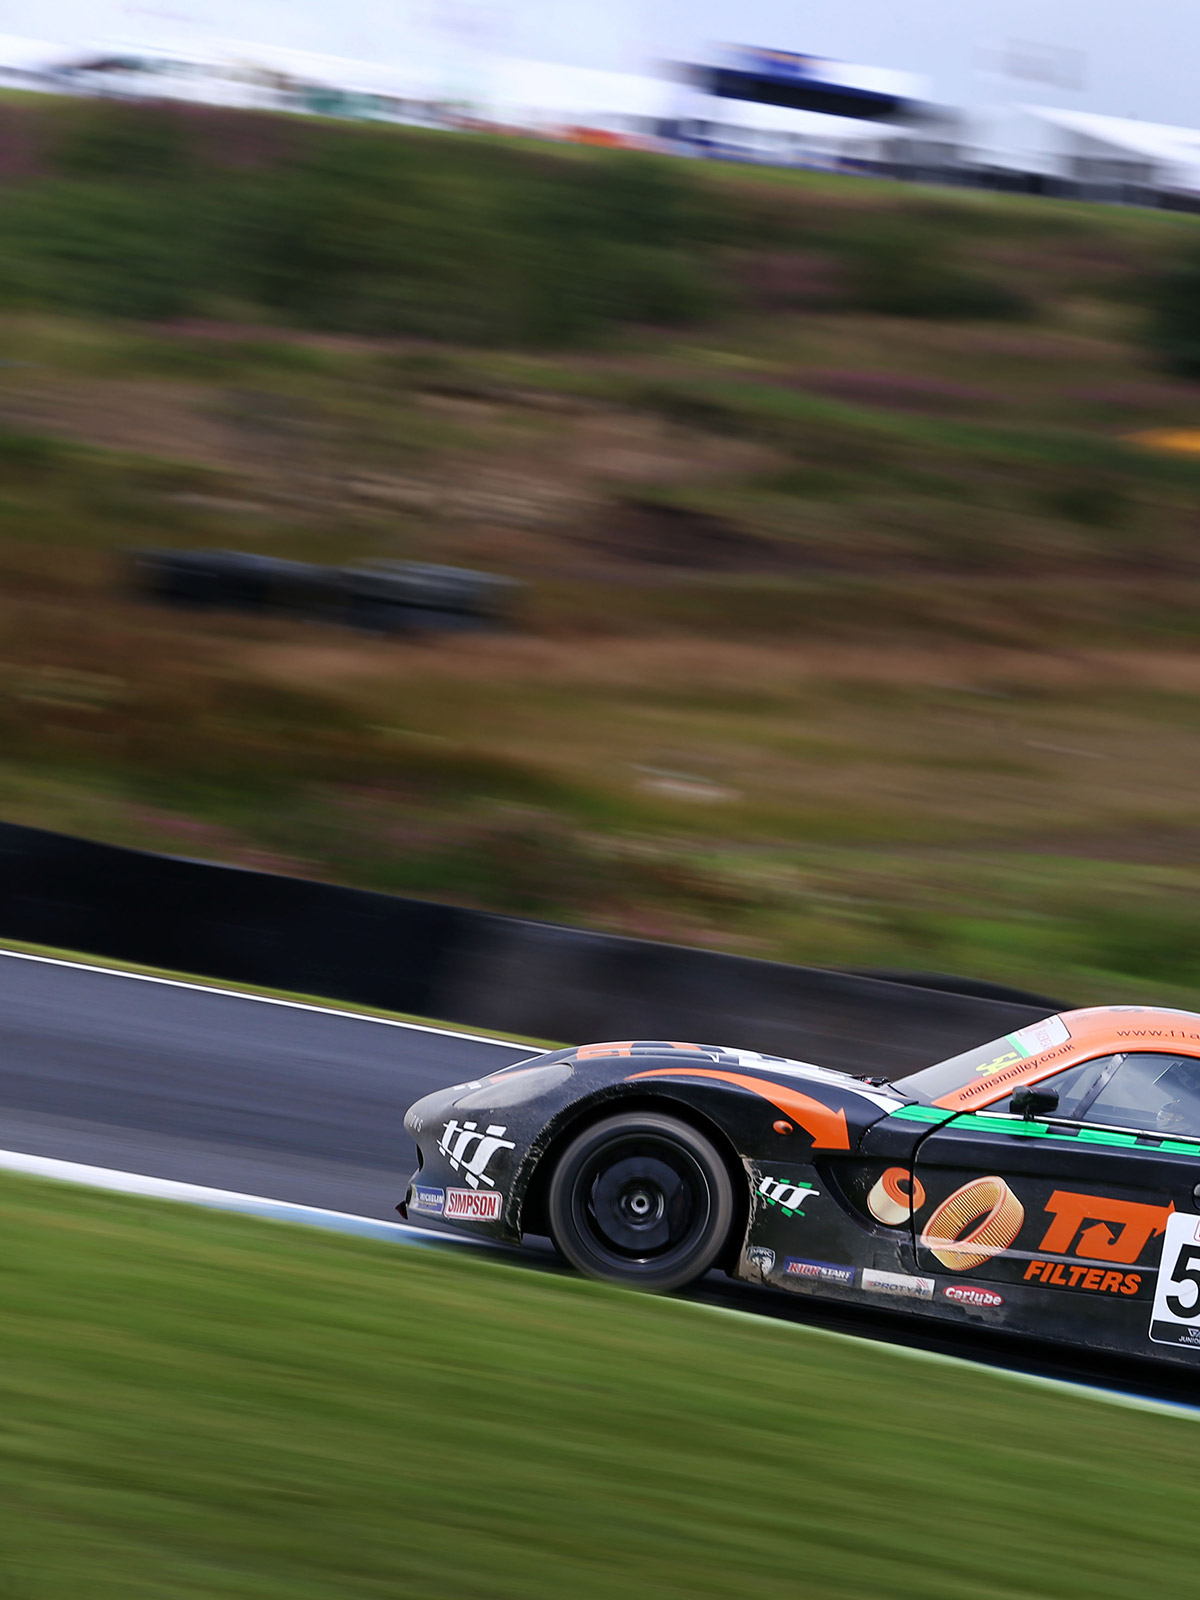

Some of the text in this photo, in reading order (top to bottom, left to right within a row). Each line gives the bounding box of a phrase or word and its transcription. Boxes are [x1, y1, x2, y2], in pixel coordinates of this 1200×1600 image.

[959, 1043, 1075, 1102] adamsmalley.co.uk
[448, 1192, 496, 1216] SIMPSON
[1023, 1260, 1142, 1295] FILTERS
[945, 1287, 1002, 1306] Carlube
